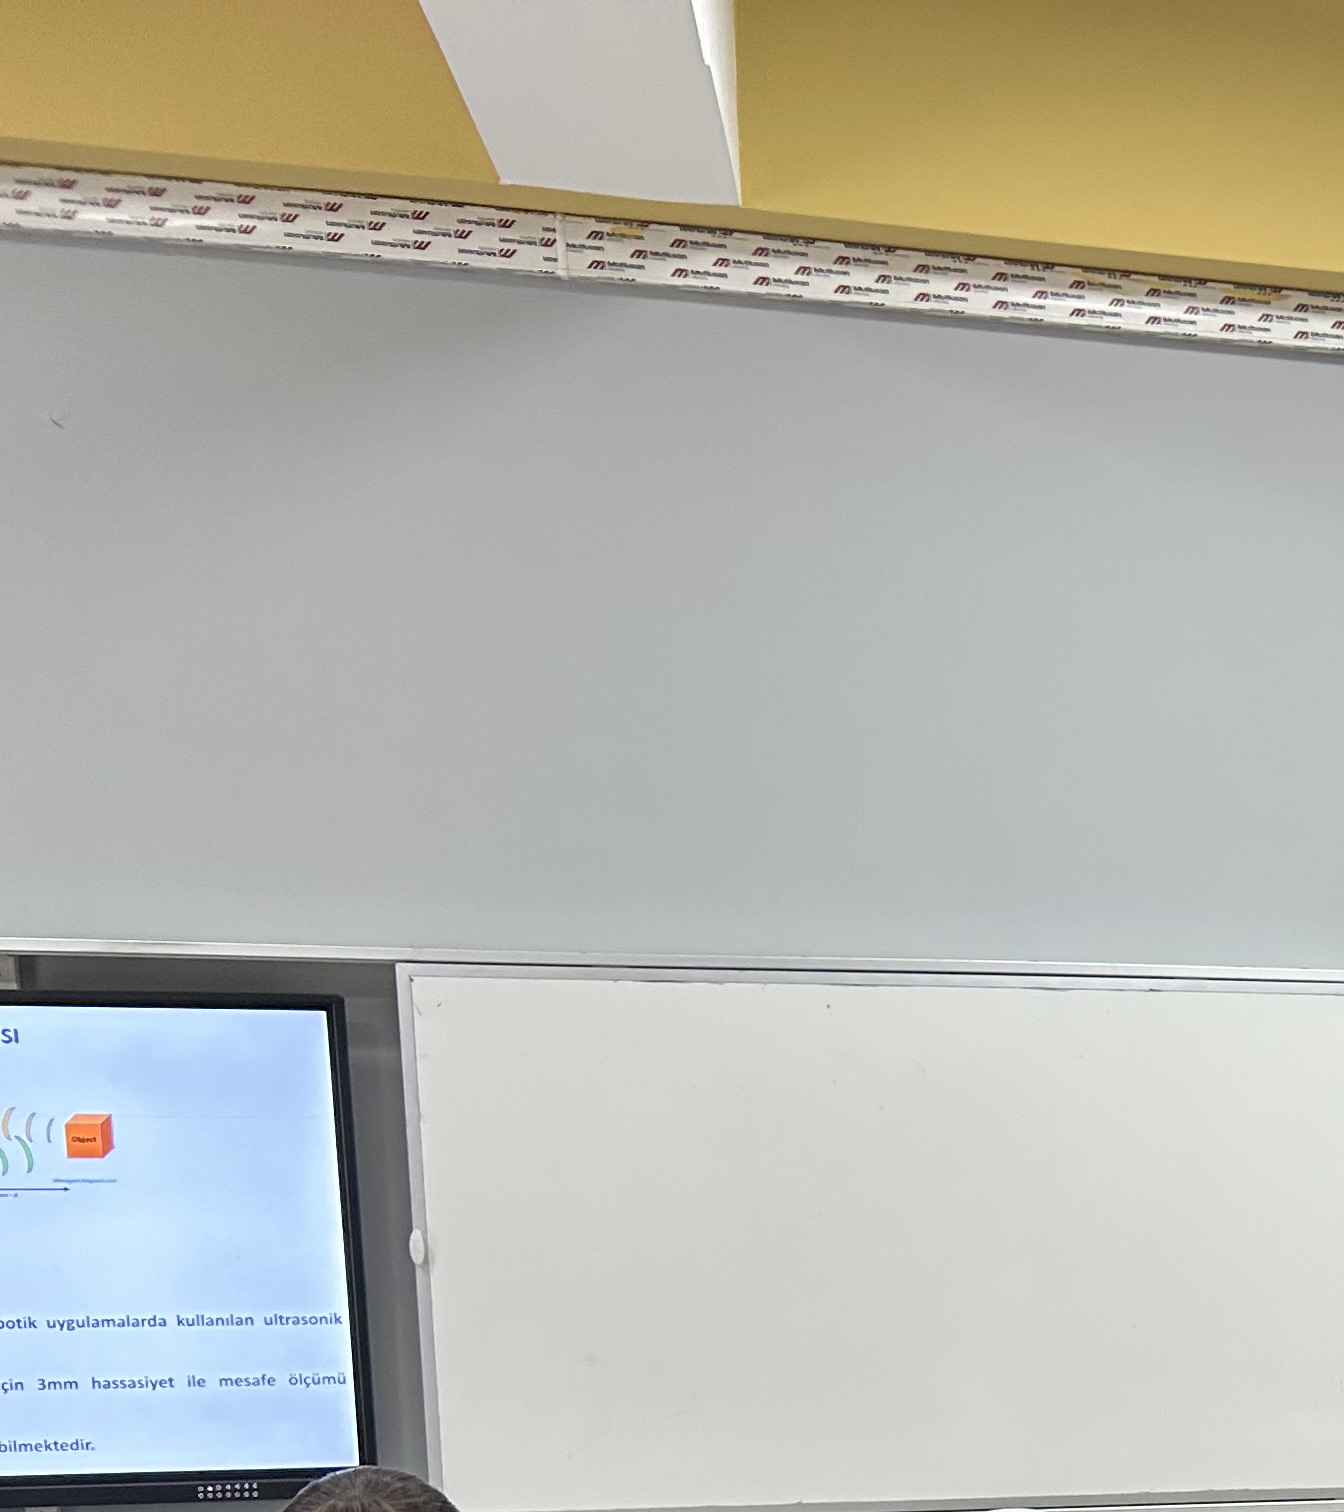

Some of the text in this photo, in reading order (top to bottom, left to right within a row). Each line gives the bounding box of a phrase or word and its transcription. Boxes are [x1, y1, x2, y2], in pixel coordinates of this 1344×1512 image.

[47, 1315, 167, 1331] uygulamalarda
[176, 1314, 254, 1327] kullanılan
[264, 1313, 343, 1326] ultrasonik
[37, 1378, 79, 1390] 3mm
[91, 1376, 175, 1391] hassasiyet
[187, 1375, 206, 1388] ile
[219, 1374, 276, 1387] mesafe
[288, 1372, 347, 1388] ölçümü
